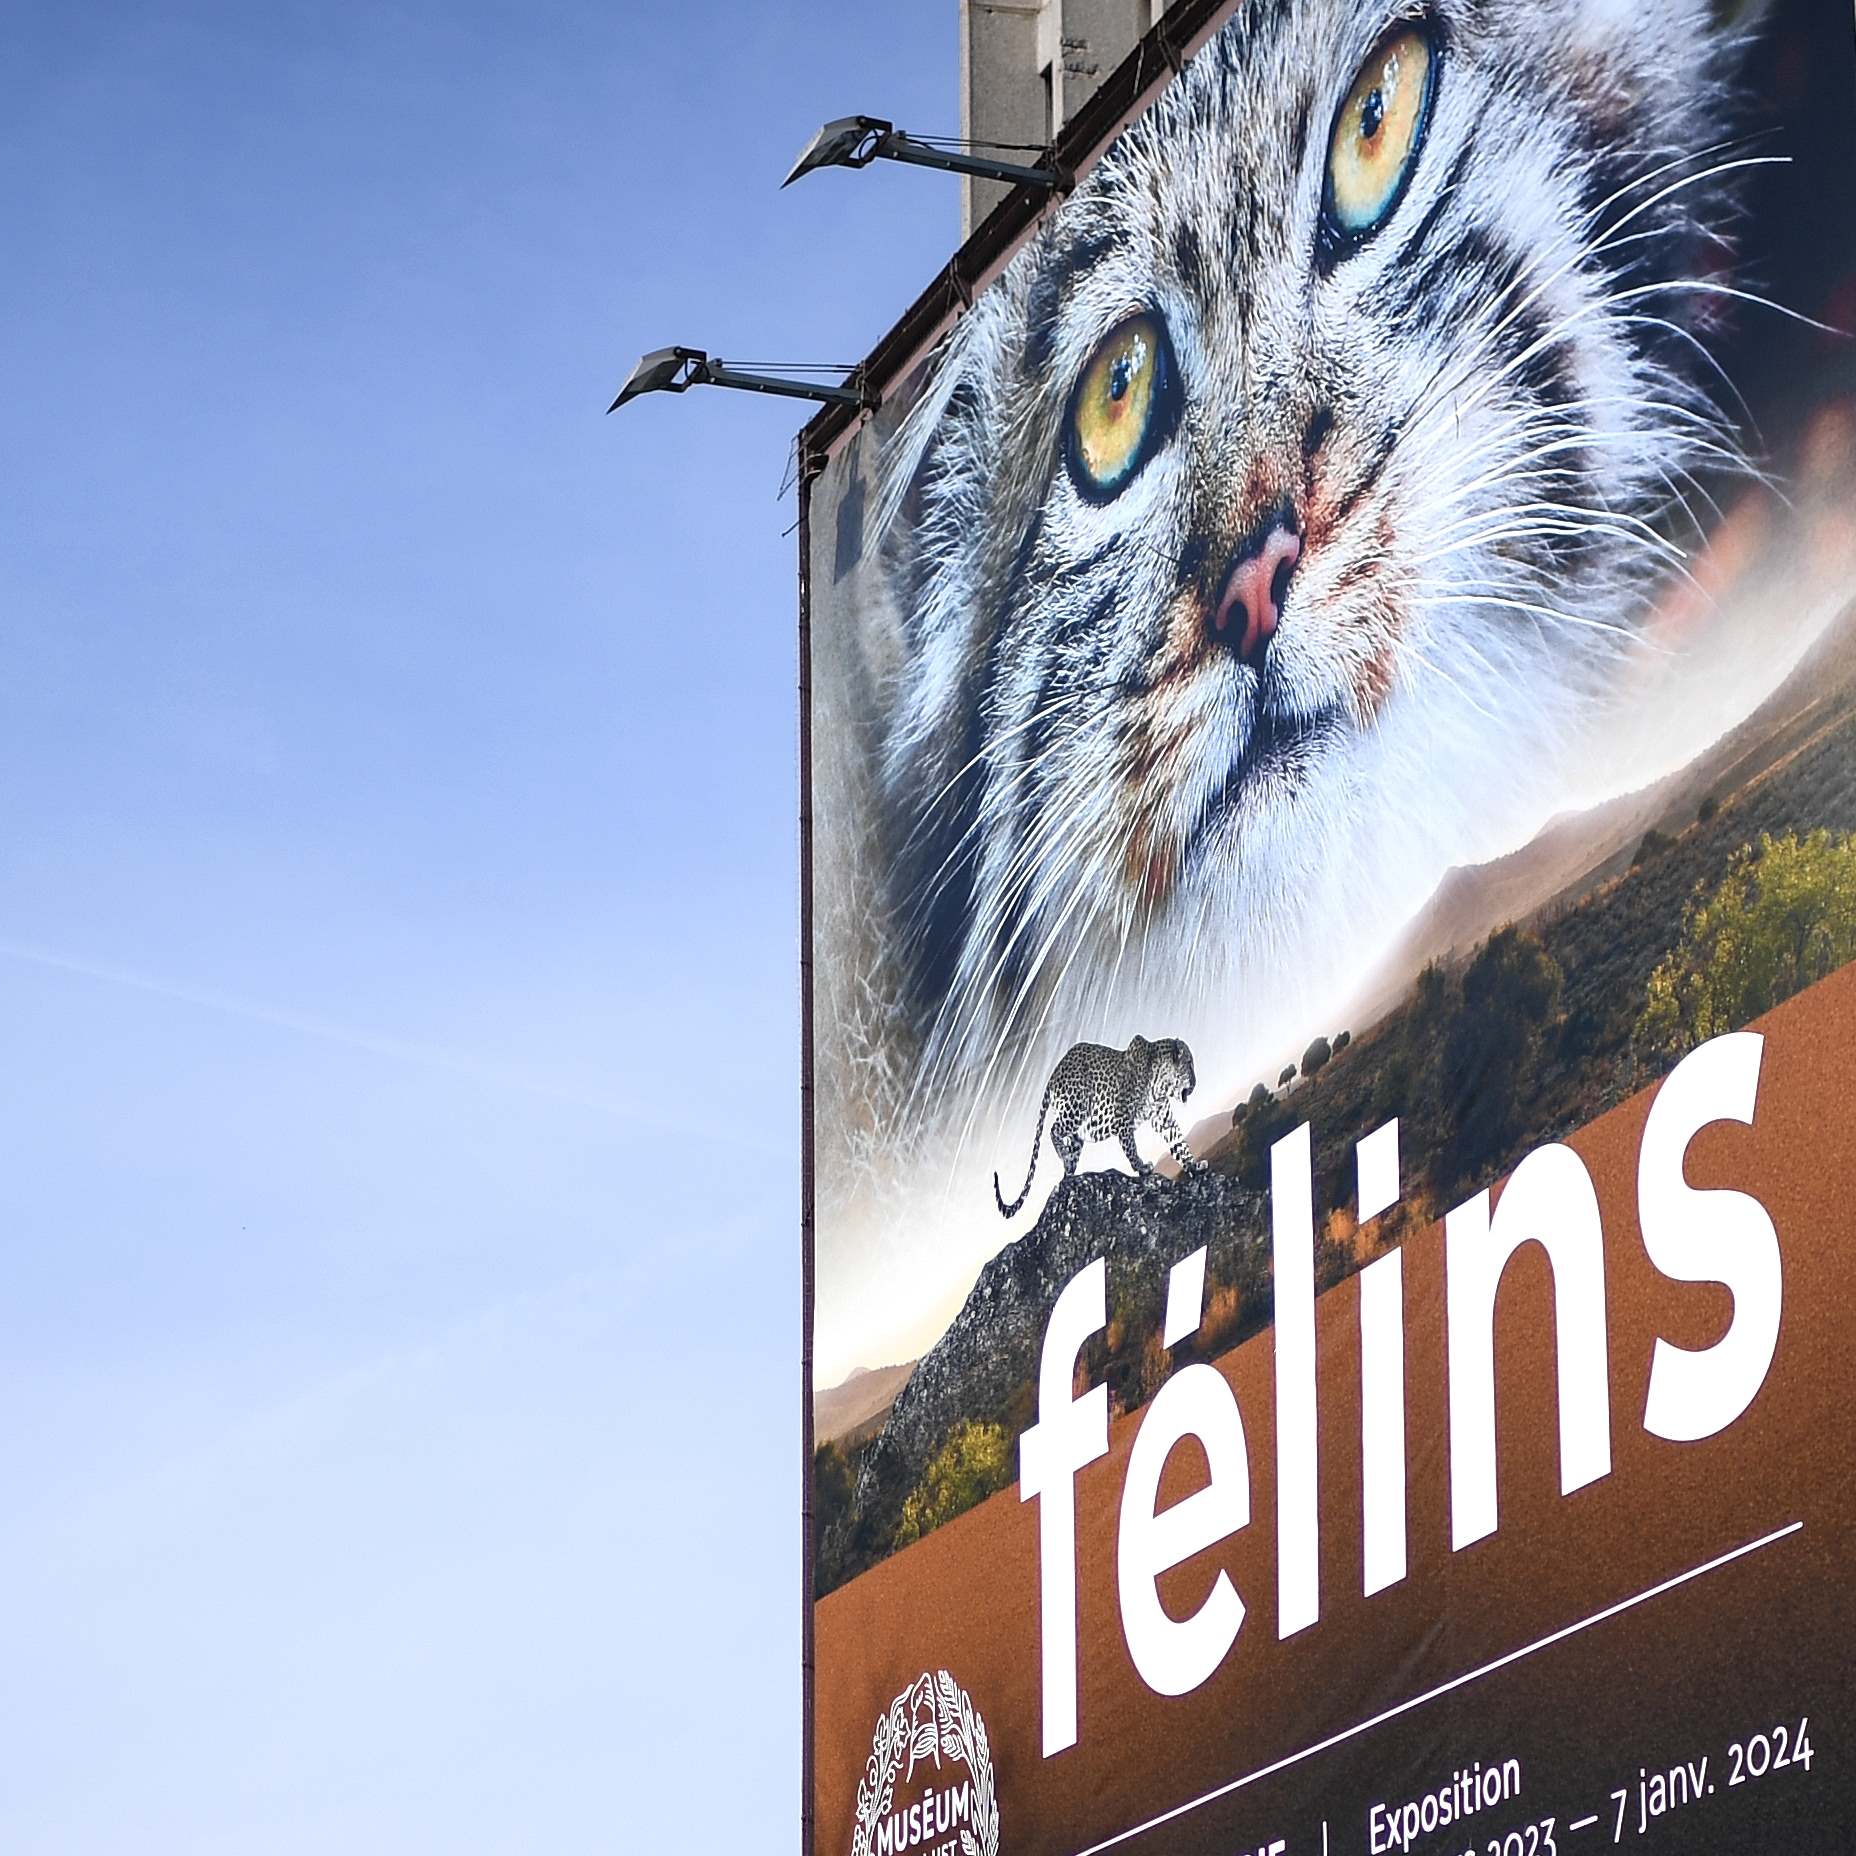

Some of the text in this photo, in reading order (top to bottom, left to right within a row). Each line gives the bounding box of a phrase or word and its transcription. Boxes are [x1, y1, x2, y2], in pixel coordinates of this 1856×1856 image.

[1019, 1030, 1784, 1759] félins
[1369, 1758, 1521, 1855] Exposition
[1610, 1789, 1628, 1843] 7
[1638, 1756, 1716, 1834] janv.
[1726, 1717, 1815, 1786] 2024
